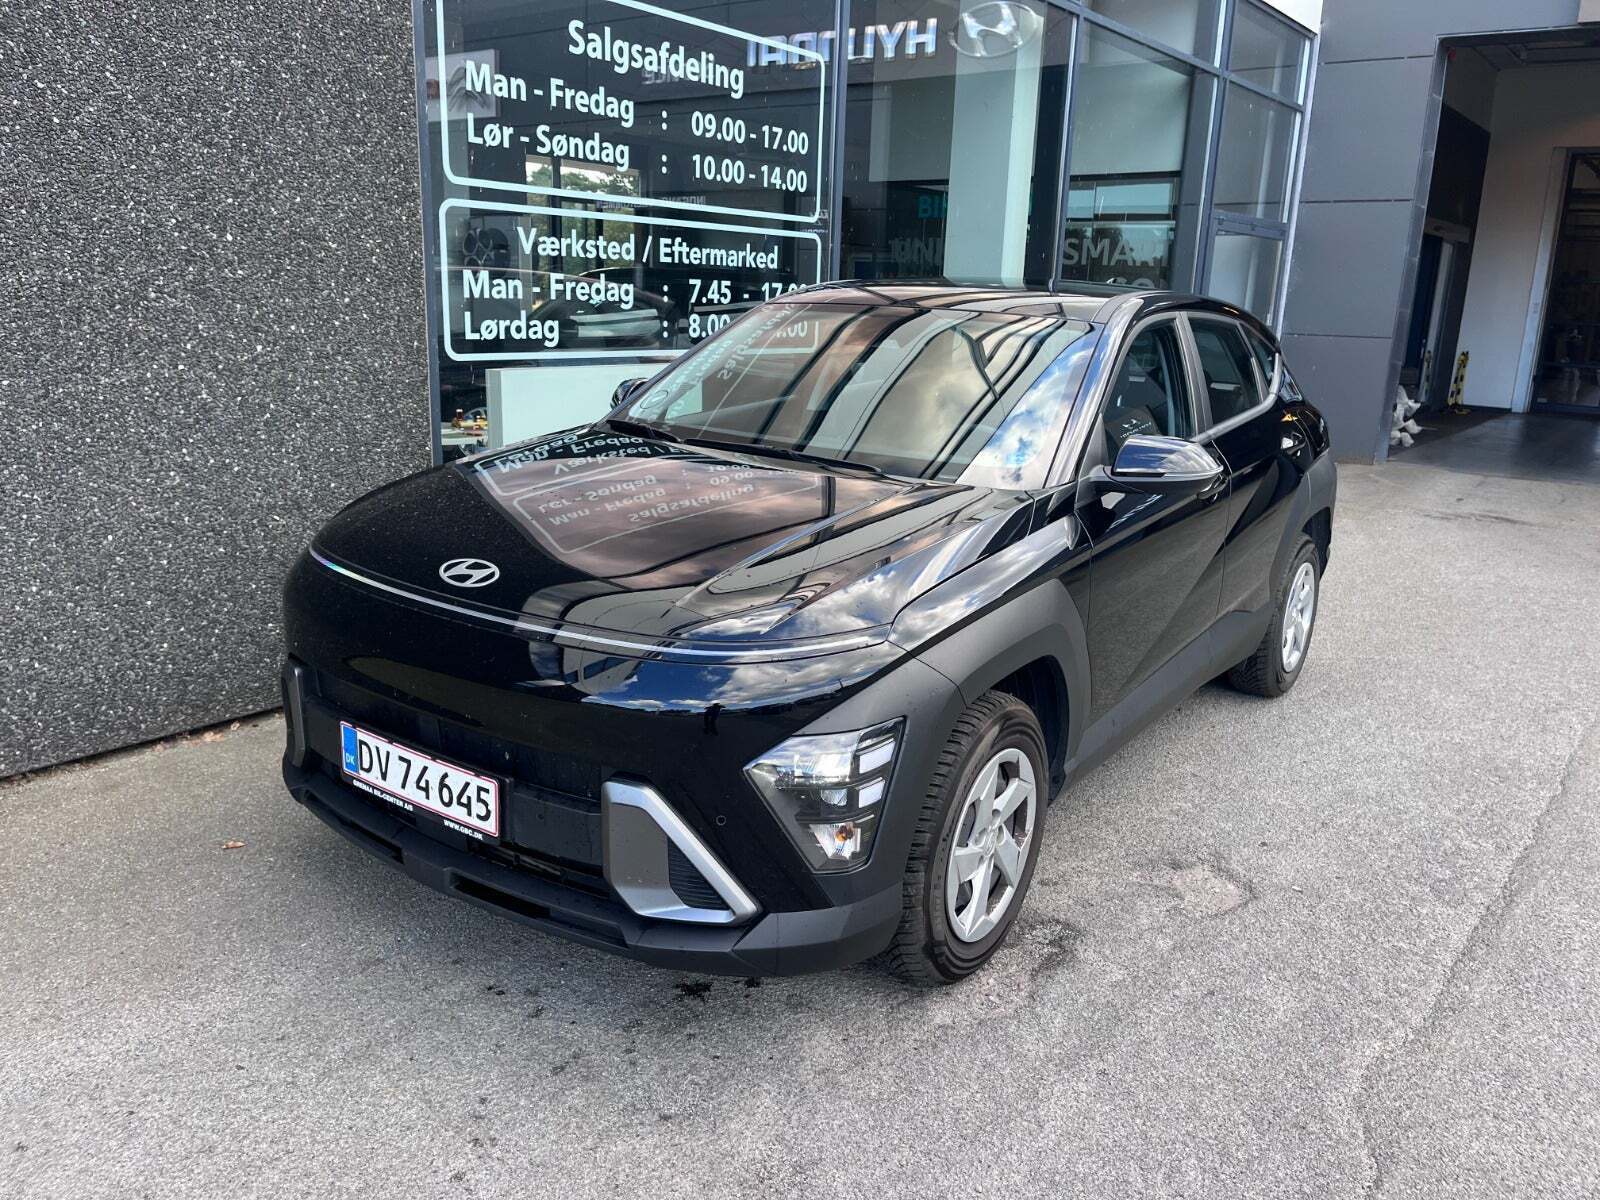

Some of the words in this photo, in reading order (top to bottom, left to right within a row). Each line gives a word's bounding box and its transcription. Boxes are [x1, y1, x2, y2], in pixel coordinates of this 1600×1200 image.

[568, 20, 744, 99] Salgsafdeling
[465, 60, 527, 101] Man
[550, 78, 635, 128] Fredag
[691, 111, 746, 144] 09.00
[761, 125, 809, 155] 17.00
[467, 113, 513, 148] Lør
[536, 125, 630, 172] Søndag
[692, 154, 745, 184] 10.00
[761, 167, 808, 192] 14.00
[517, 226, 635, 262] Værksted
[644, 234, 653, 263] /
[659, 238, 779, 270] Eftermarked
[463, 270, 523, 300] Man
[550, 274, 634, 310] Fredag
[689, 279, 732, 304] 7.45
[464, 311, 560, 348] Lørdag
[689, 314, 731, 338] 8.00
[358, 738, 391, 782] DV
[398, 755, 431, 801] 74
[437, 771, 492, 822] 645
